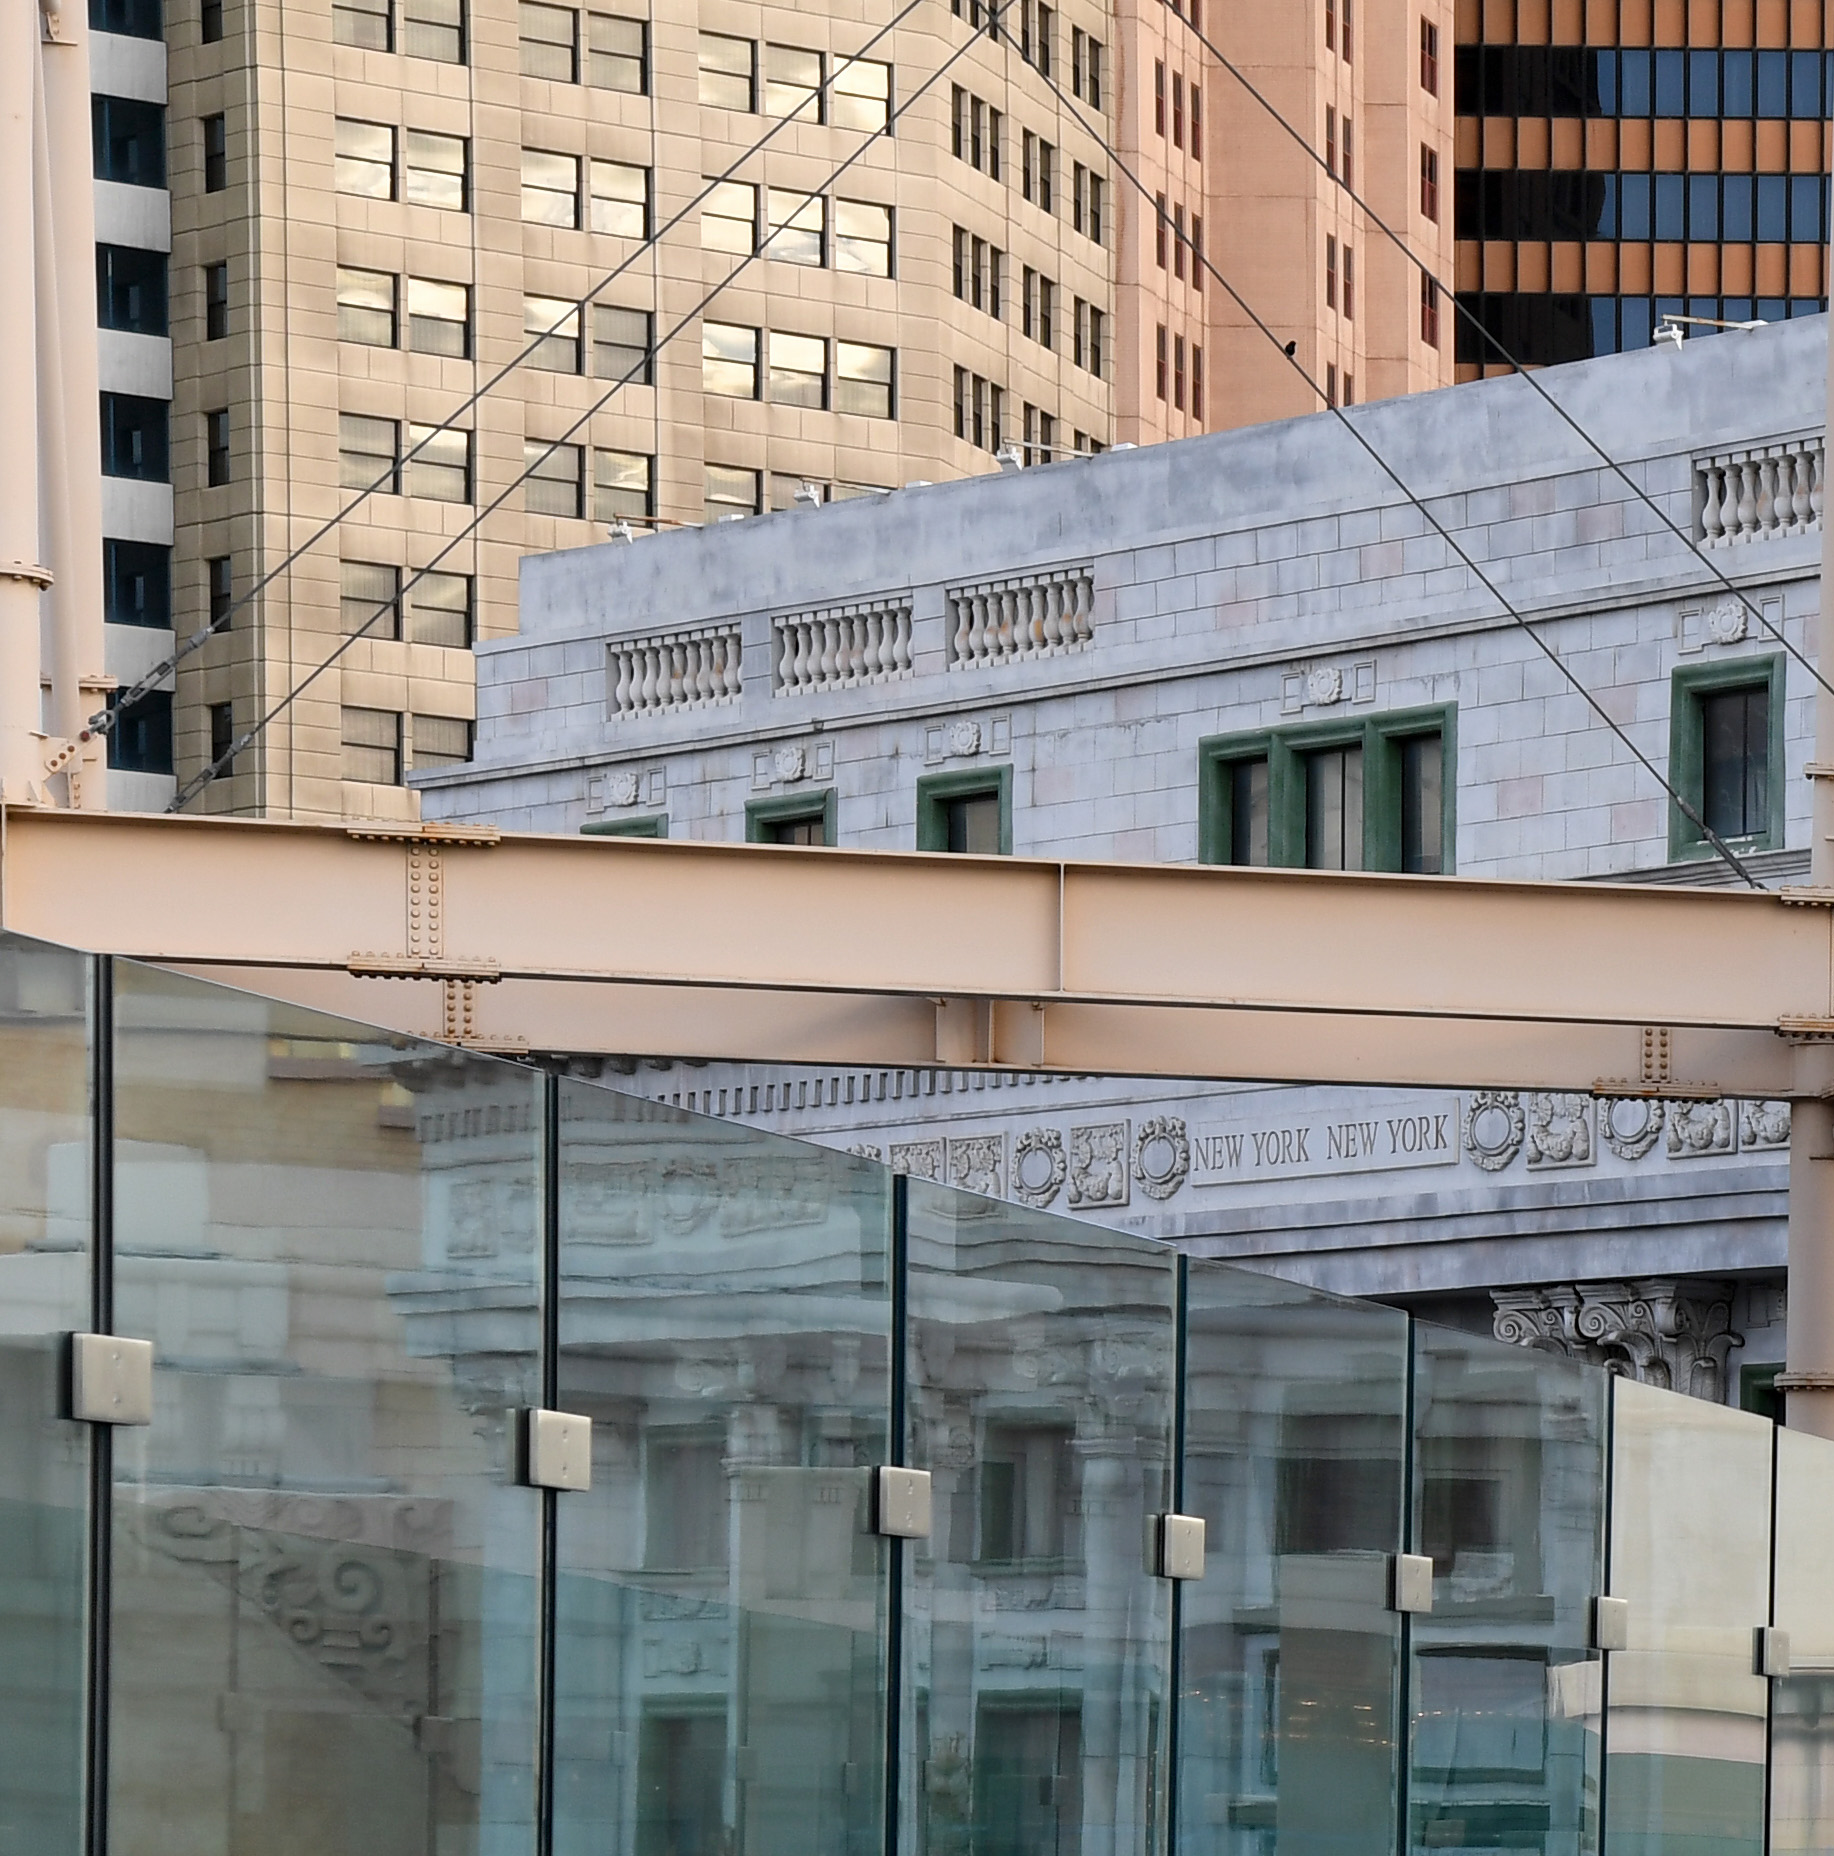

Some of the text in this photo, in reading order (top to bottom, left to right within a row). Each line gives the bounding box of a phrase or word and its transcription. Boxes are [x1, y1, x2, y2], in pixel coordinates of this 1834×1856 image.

[1193, 1114, 1449, 1172] NEW YORK NEW YORK
